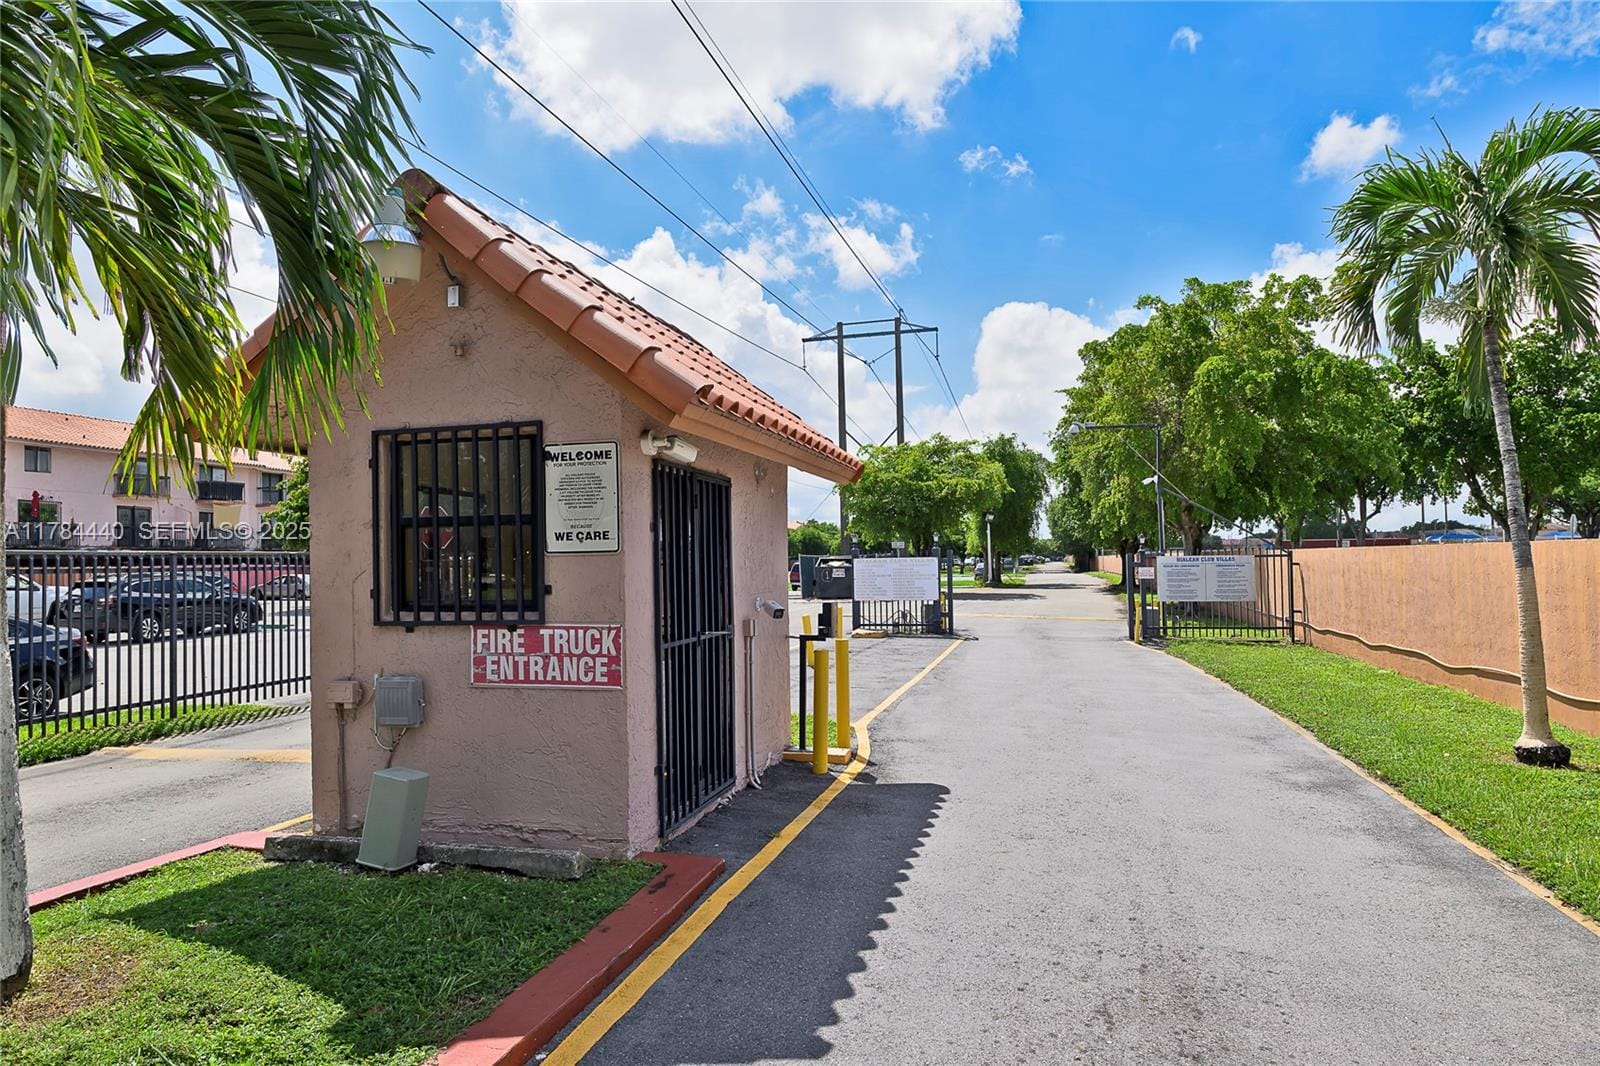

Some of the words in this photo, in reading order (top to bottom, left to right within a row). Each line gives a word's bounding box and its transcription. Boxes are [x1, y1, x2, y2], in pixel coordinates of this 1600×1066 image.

[550, 450, 612, 462] WELCOME
[554, 532, 573, 541] WE
[576, 531, 610, 541] CARE
[476, 628, 525, 653] FIRE
[540, 629, 617, 656] TRUCK
[486, 655, 608, 683] ENTRANCE
